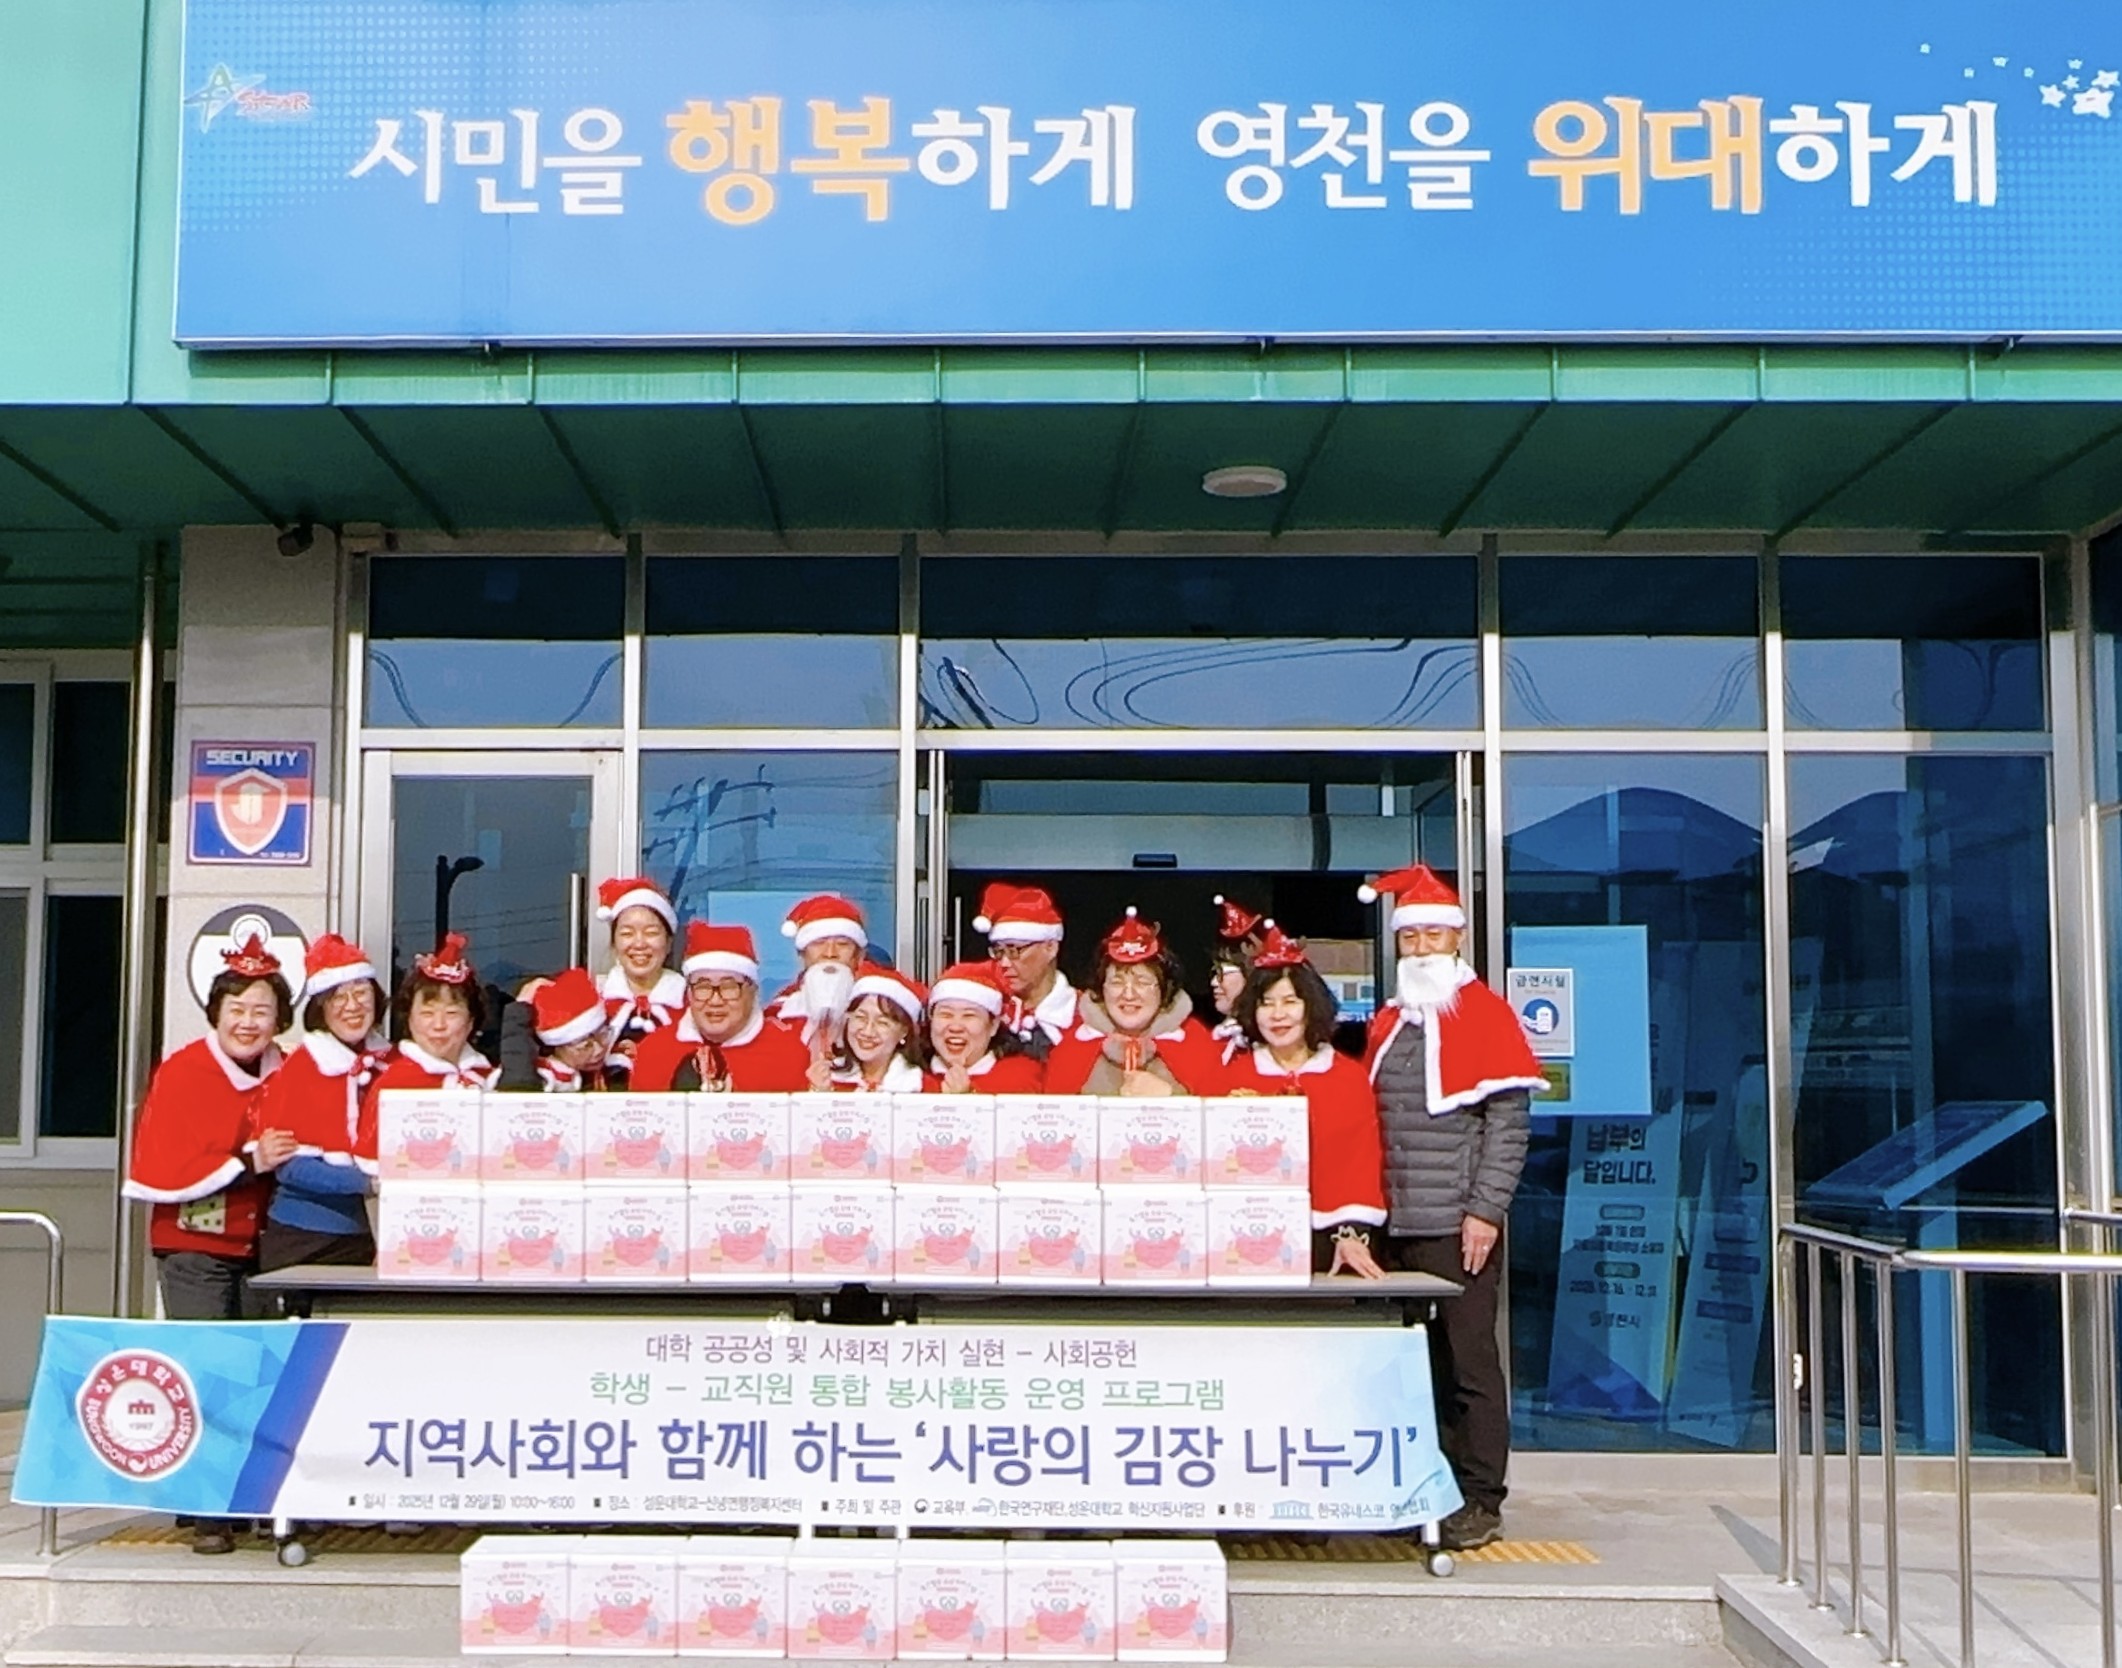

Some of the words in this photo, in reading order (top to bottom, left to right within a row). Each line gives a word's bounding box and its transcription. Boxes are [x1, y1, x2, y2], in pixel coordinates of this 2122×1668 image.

[350, 108, 643, 215] 시민을
[663, 96, 1136, 225] 행복하게
[1197, 102, 1491, 211] 영천을
[1527, 96, 1998, 216] 위대하게
[206, 750, 299, 766] SECURITY
[1583, 1160, 1656, 1185] 달입니다.
[647, 1334, 692, 1363] 대학
[703, 1335, 773, 1364] 공공성
[786, 1336, 807, 1364] 및
[819, 1337, 889, 1367] 사회적
[901, 1339, 946, 1368] 가치
[959, 1339, 1005, 1368] 실현
[1044, 1340, 1137, 1369] 사회공헌
[590, 1373, 650, 1406] 학생
[701, 1373, 793, 1406] 교직원
[810, 1375, 871, 1407] 통합
[886, 1377, 1009, 1411] 봉사활동
[1024, 1377, 1085, 1411] 운영
[1101, 1379, 1225, 1411] 프로그램
[365, 1418, 637, 1480] 지역사회와
[657, 1418, 767, 1481] 함께
[791, 1421, 902, 1483] 하는
[1114, 1425, 1224, 1488] 김장
[363, 1493, 386, 1510] 일시
[608, 1495, 631, 1511] 장소
[863, 1498, 874, 1515] 및
[879, 1499, 902, 1516] 주관
[1233, 1501, 1256, 1519] 후원
[1318, 1502, 1385, 1520] 한국유네스코
